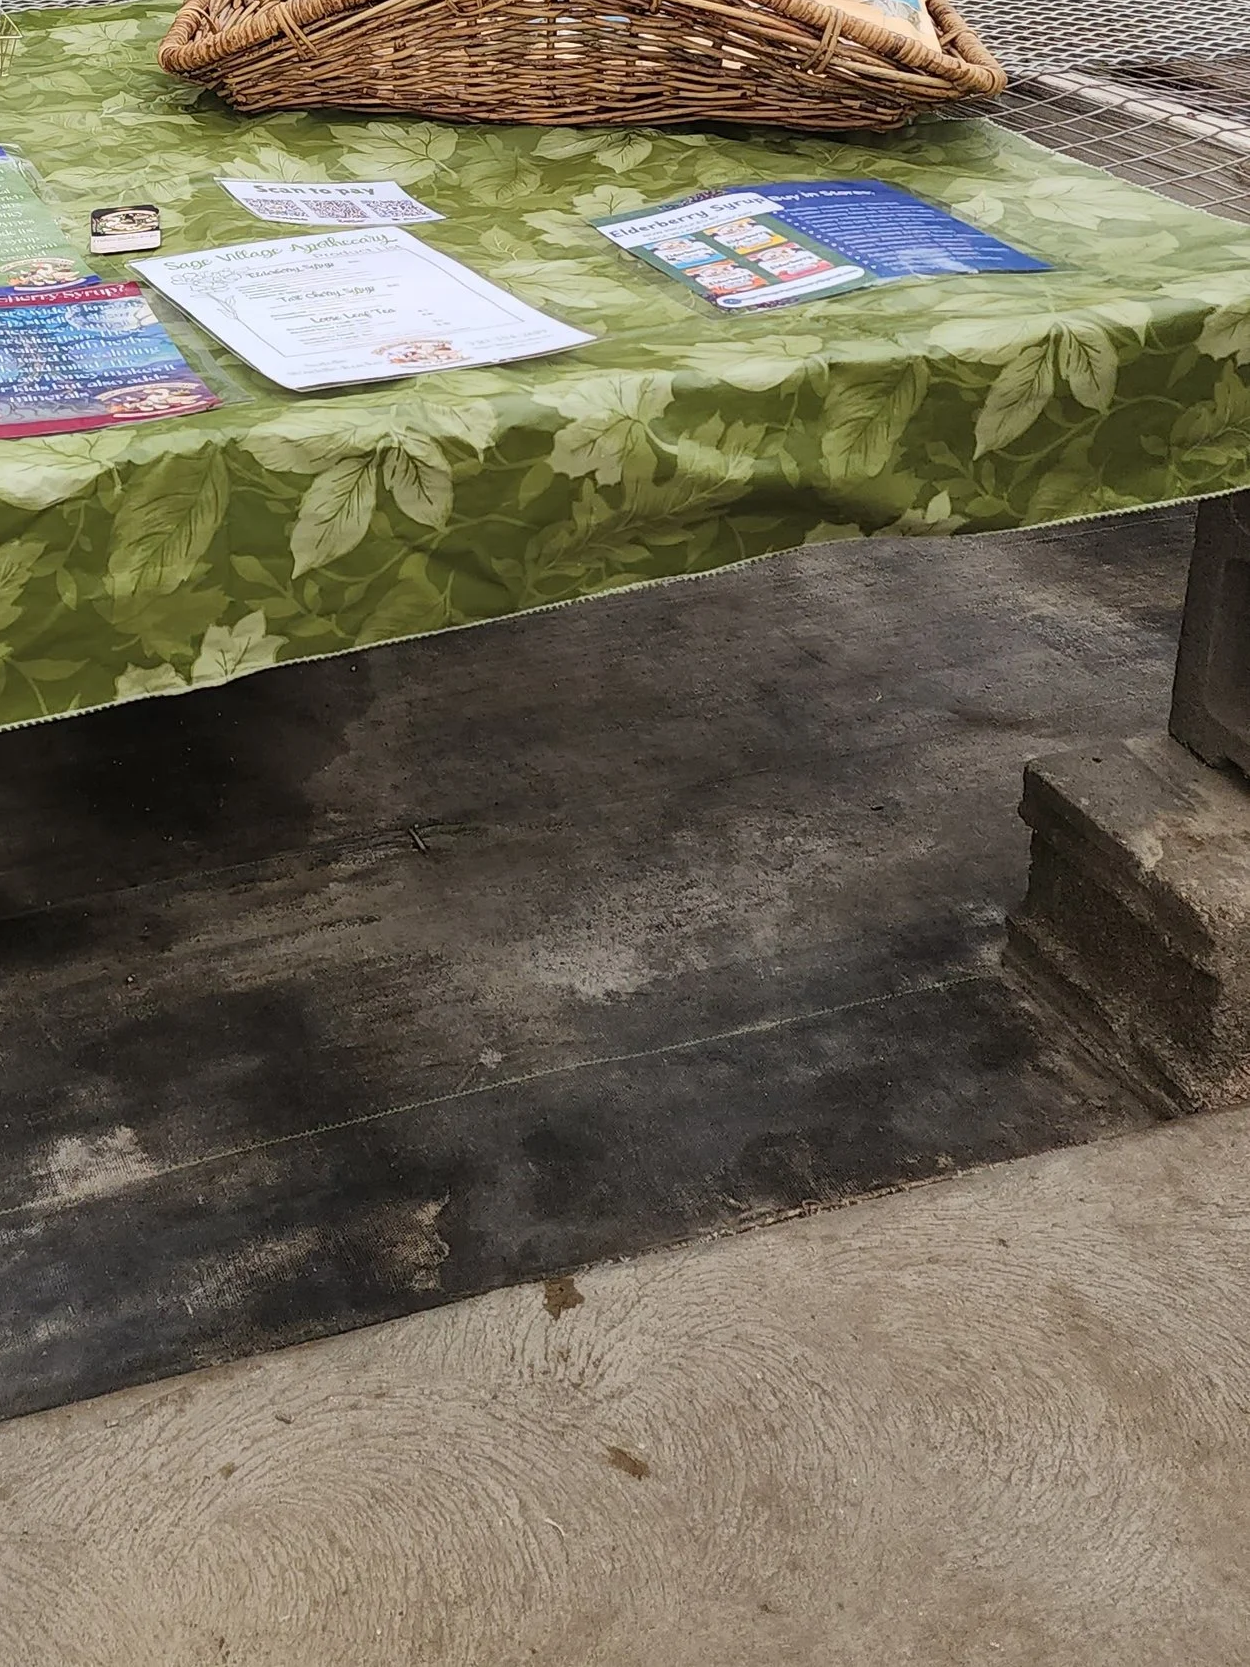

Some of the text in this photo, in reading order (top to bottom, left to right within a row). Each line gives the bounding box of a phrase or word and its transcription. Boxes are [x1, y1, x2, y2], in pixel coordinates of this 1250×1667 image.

[253, 185, 374, 196] Scan to pay
[609, 210, 709, 239] Elderberry
[709, 197, 766, 214] Syrup
[163, 233, 398, 272] Sage Village Apothecary
[61, 284, 126, 300] Syrup?
